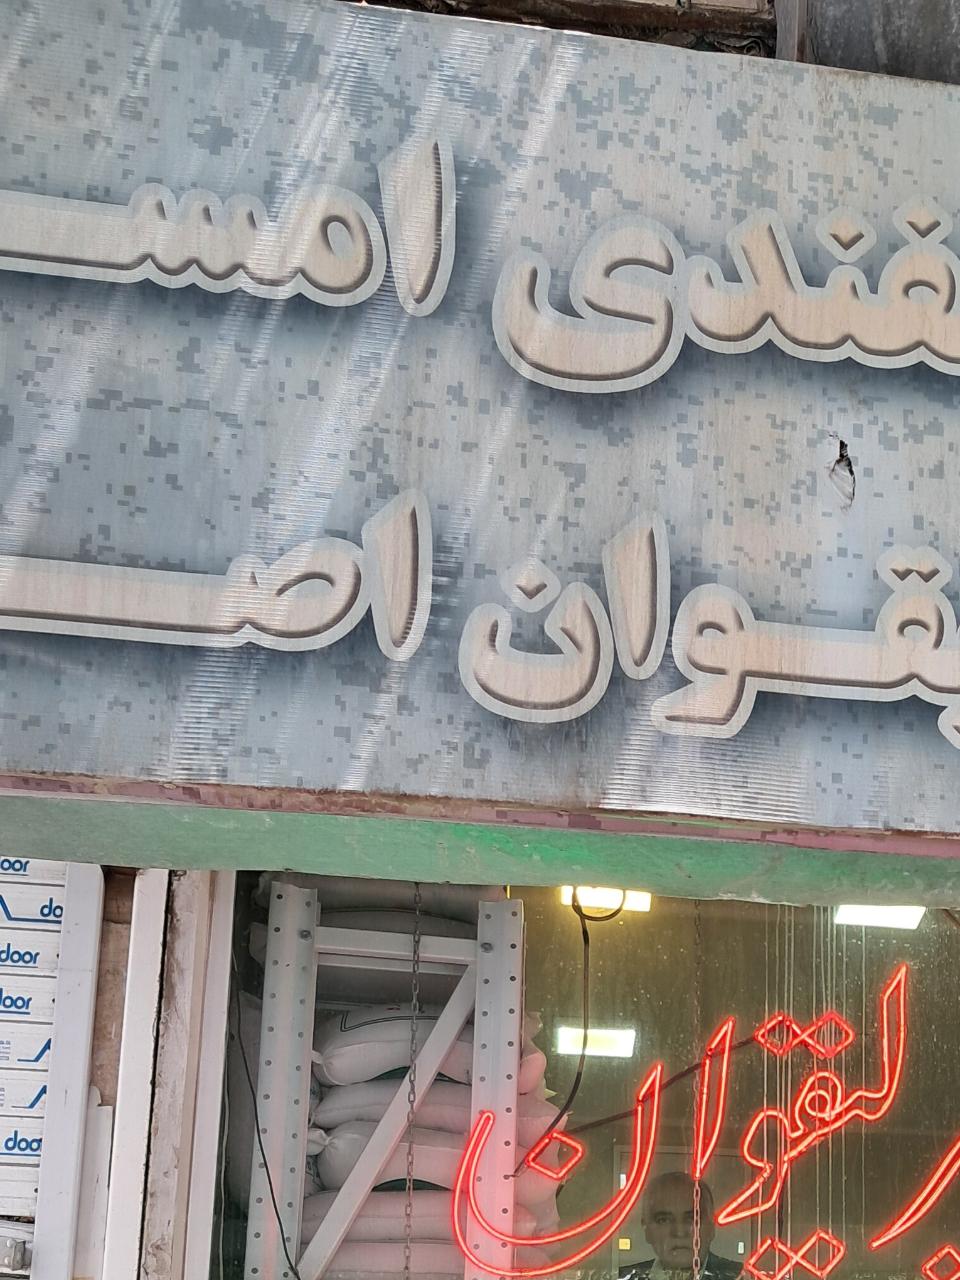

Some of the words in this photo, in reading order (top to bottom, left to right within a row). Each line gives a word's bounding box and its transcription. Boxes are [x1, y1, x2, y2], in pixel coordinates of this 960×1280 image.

[0, 139, 456, 316] امس
[0, 490, 431, 661] اص
[0, 858, 30, 873] oor
[40, 897, 64, 918] do
